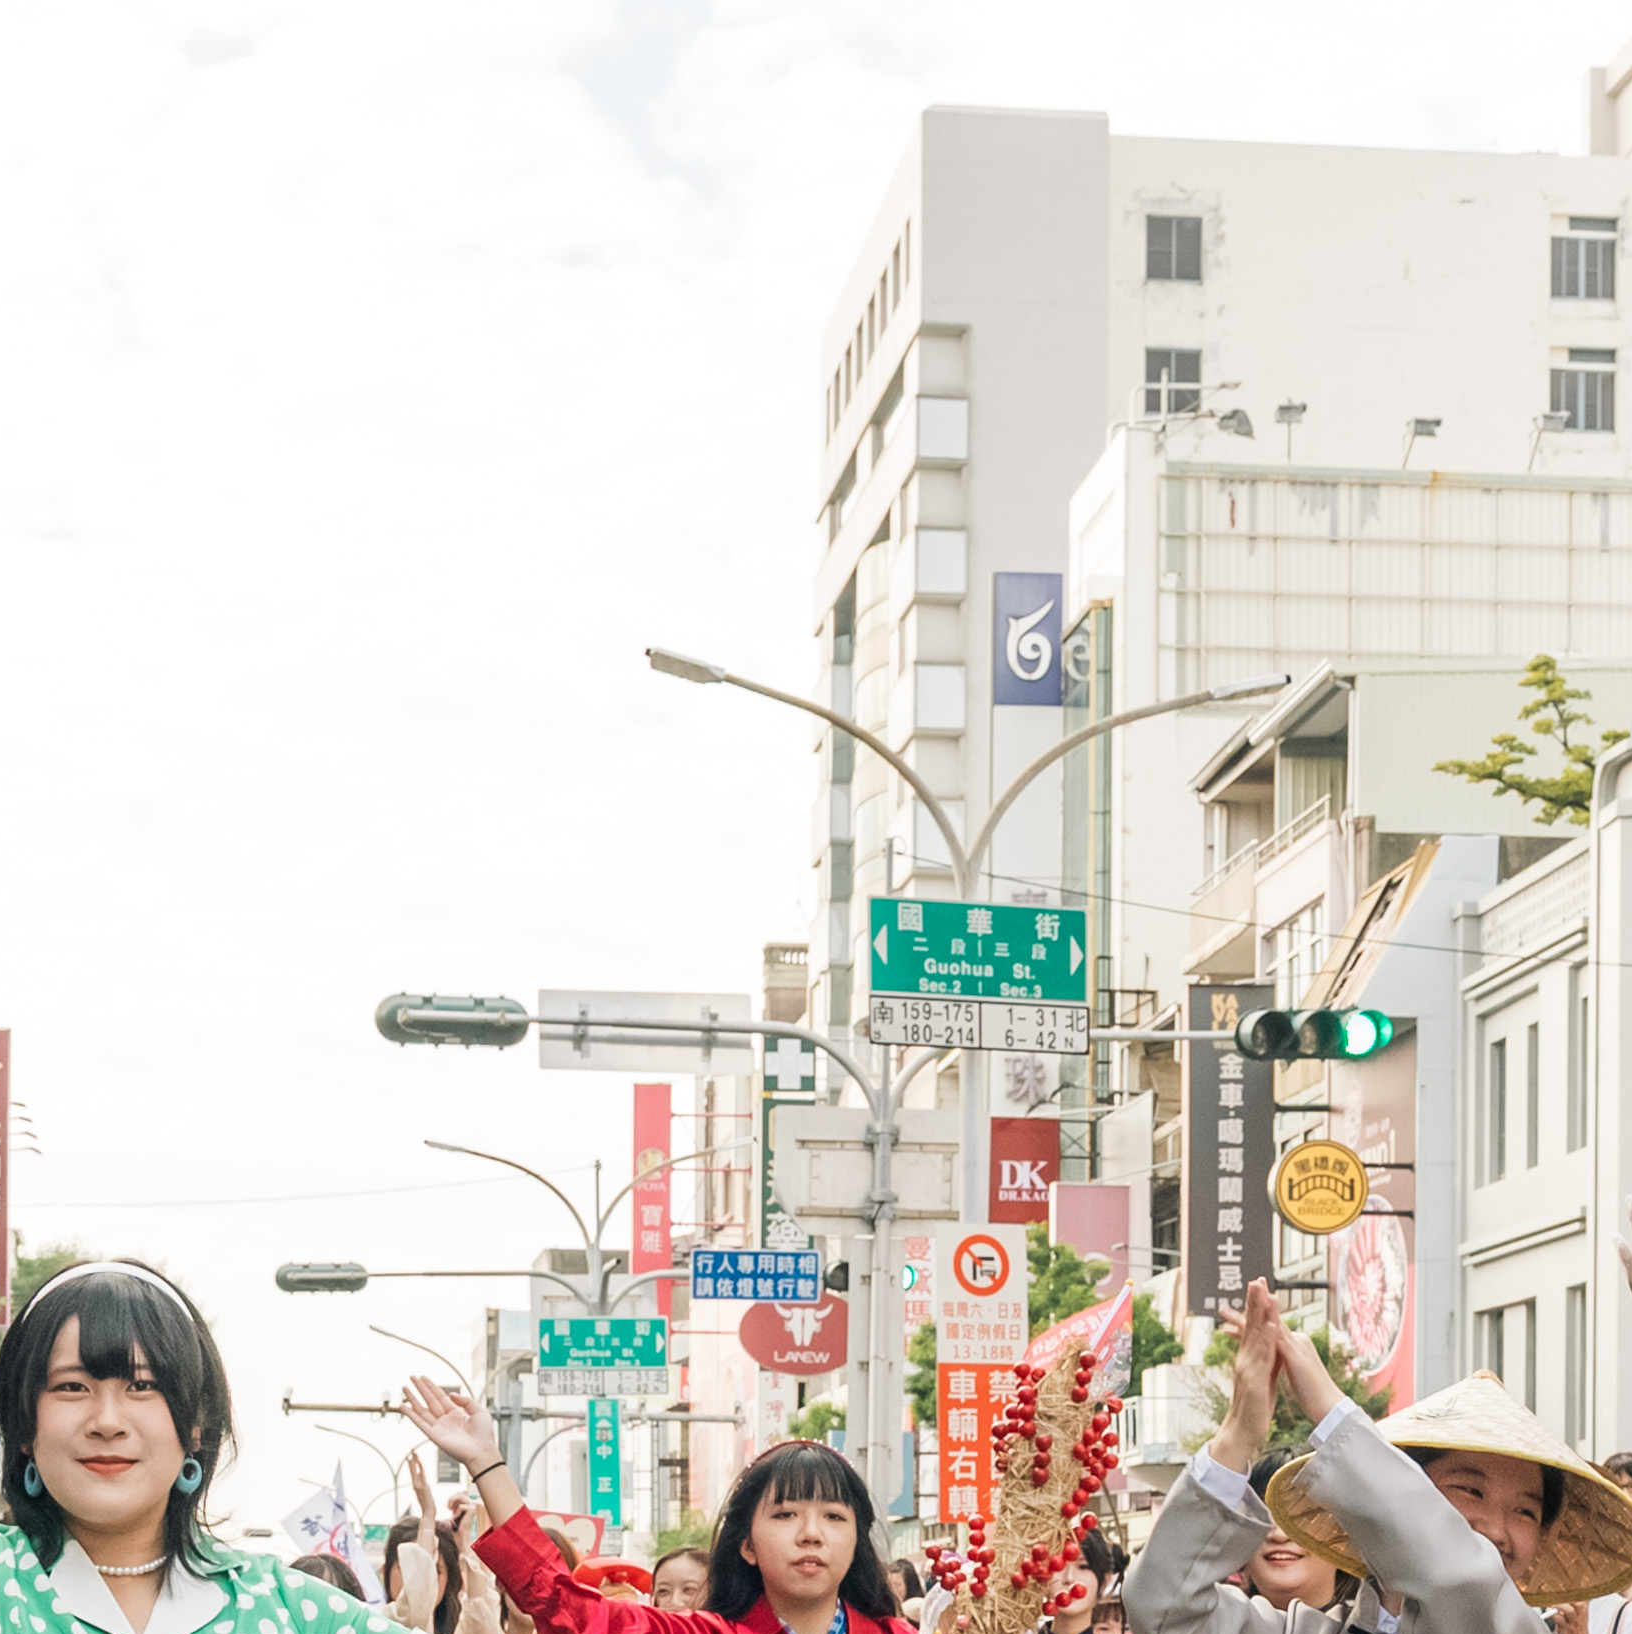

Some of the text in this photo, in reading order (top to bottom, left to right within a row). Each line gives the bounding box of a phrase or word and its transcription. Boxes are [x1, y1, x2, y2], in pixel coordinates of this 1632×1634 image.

[897, 902, 1062, 942] 國華街
[923, 958, 1036, 980] Guohua St.
[919, 978, 1043, 998] Sec.2 Sec.3
[873, 1001, 894, 1026] 南
[901, 1001, 974, 1023] 159-175
[1064, 1010, 1087, 1034] 北
[902, 1024, 975, 1046] 180-214
[999, 1160, 1049, 1190] DK
[1297, 1207, 1346, 1217] BRIDGE
[696, 1254, 818, 1276] 行人專用時相
[695, 1276, 816, 1299] 請依燈號行駛
